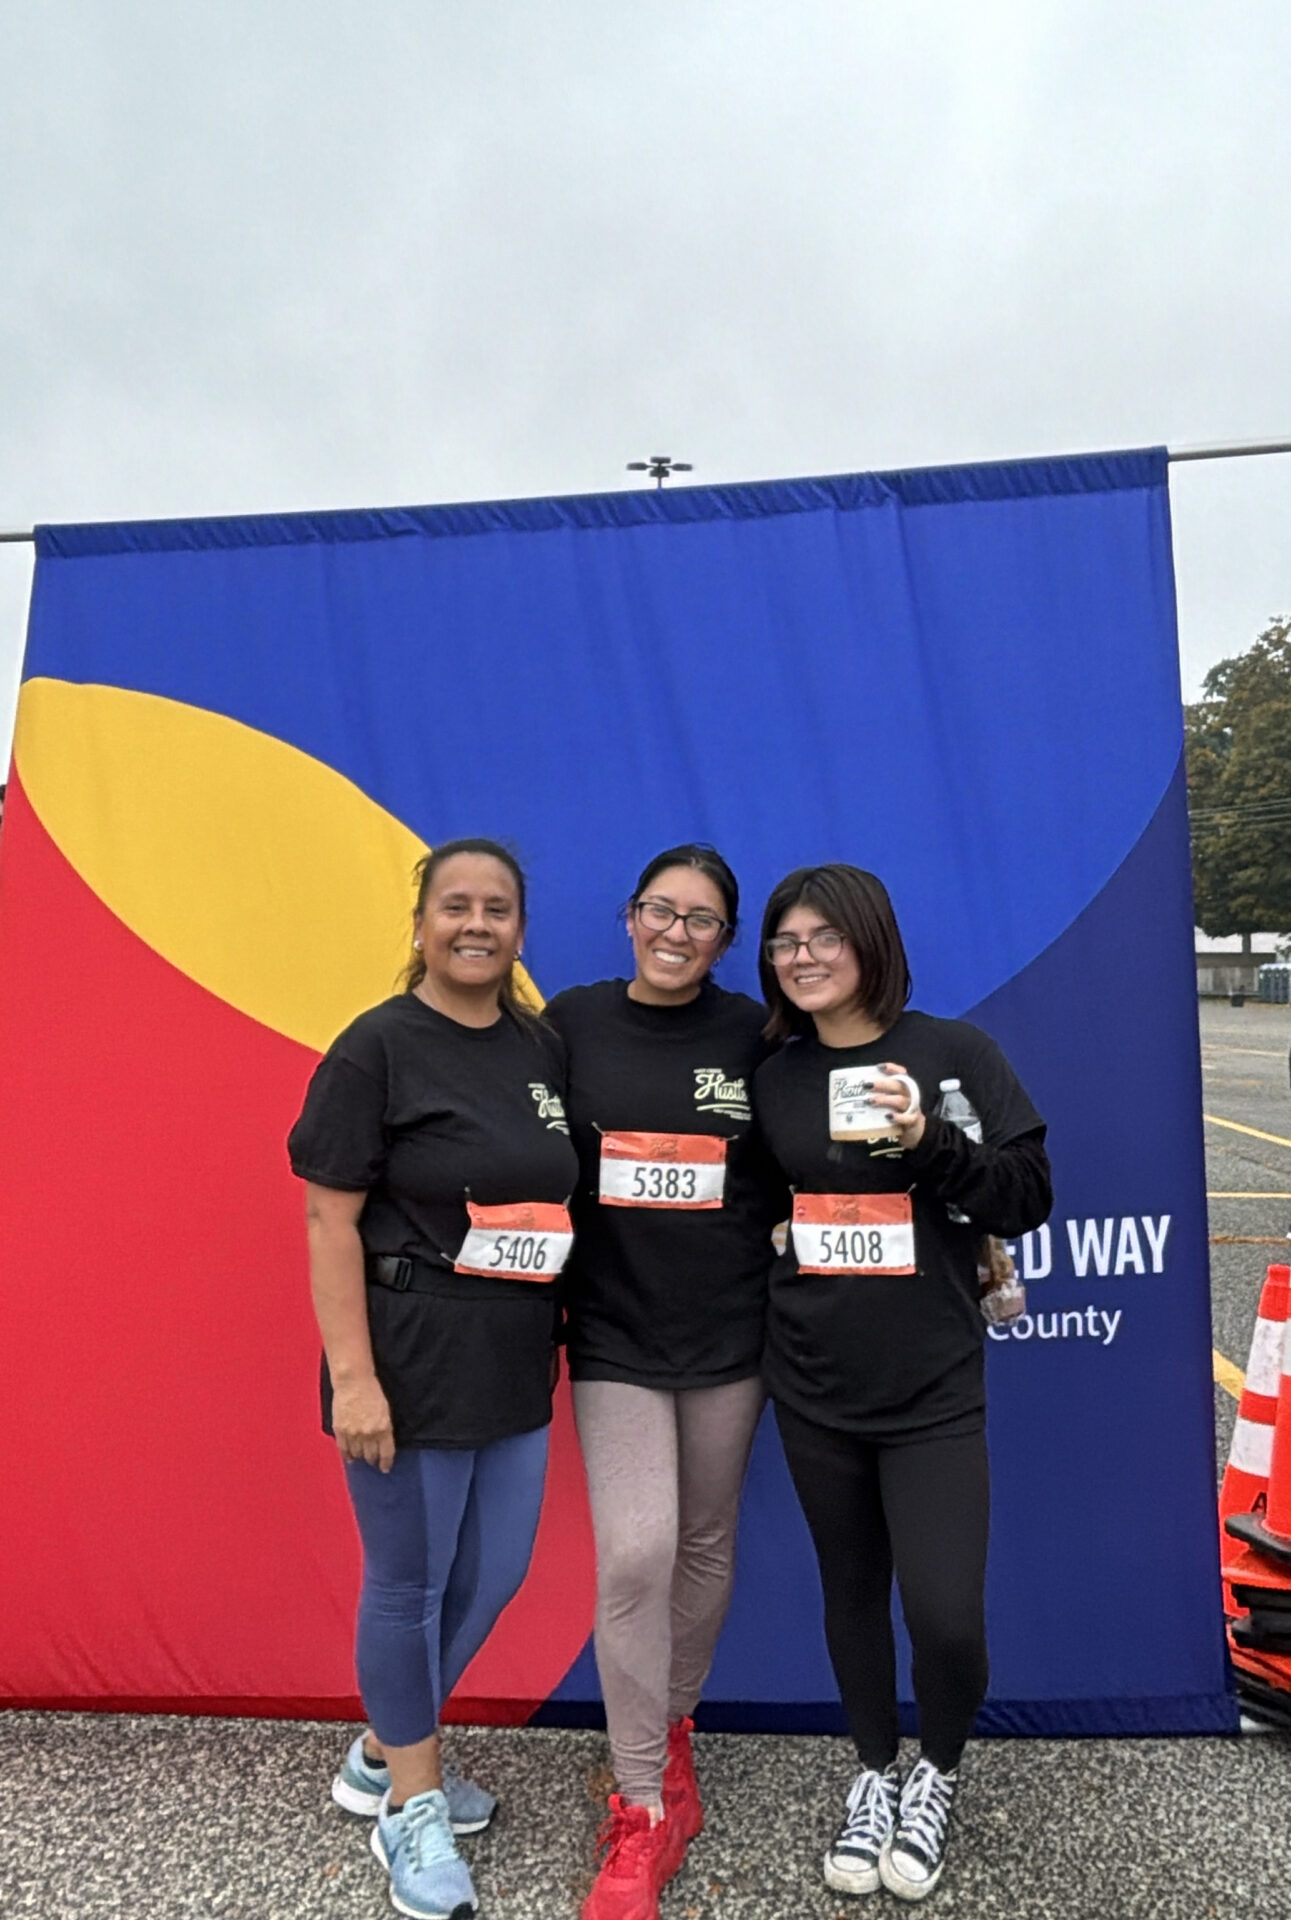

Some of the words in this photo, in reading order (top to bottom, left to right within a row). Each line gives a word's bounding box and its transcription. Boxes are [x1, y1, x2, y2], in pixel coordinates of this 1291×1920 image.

[632, 1166, 697, 1199] 5383
[488, 1234, 549, 1270] 5406
[819, 1230, 883, 1264] 5408
[1066, 1214, 1172, 1277] WAY
